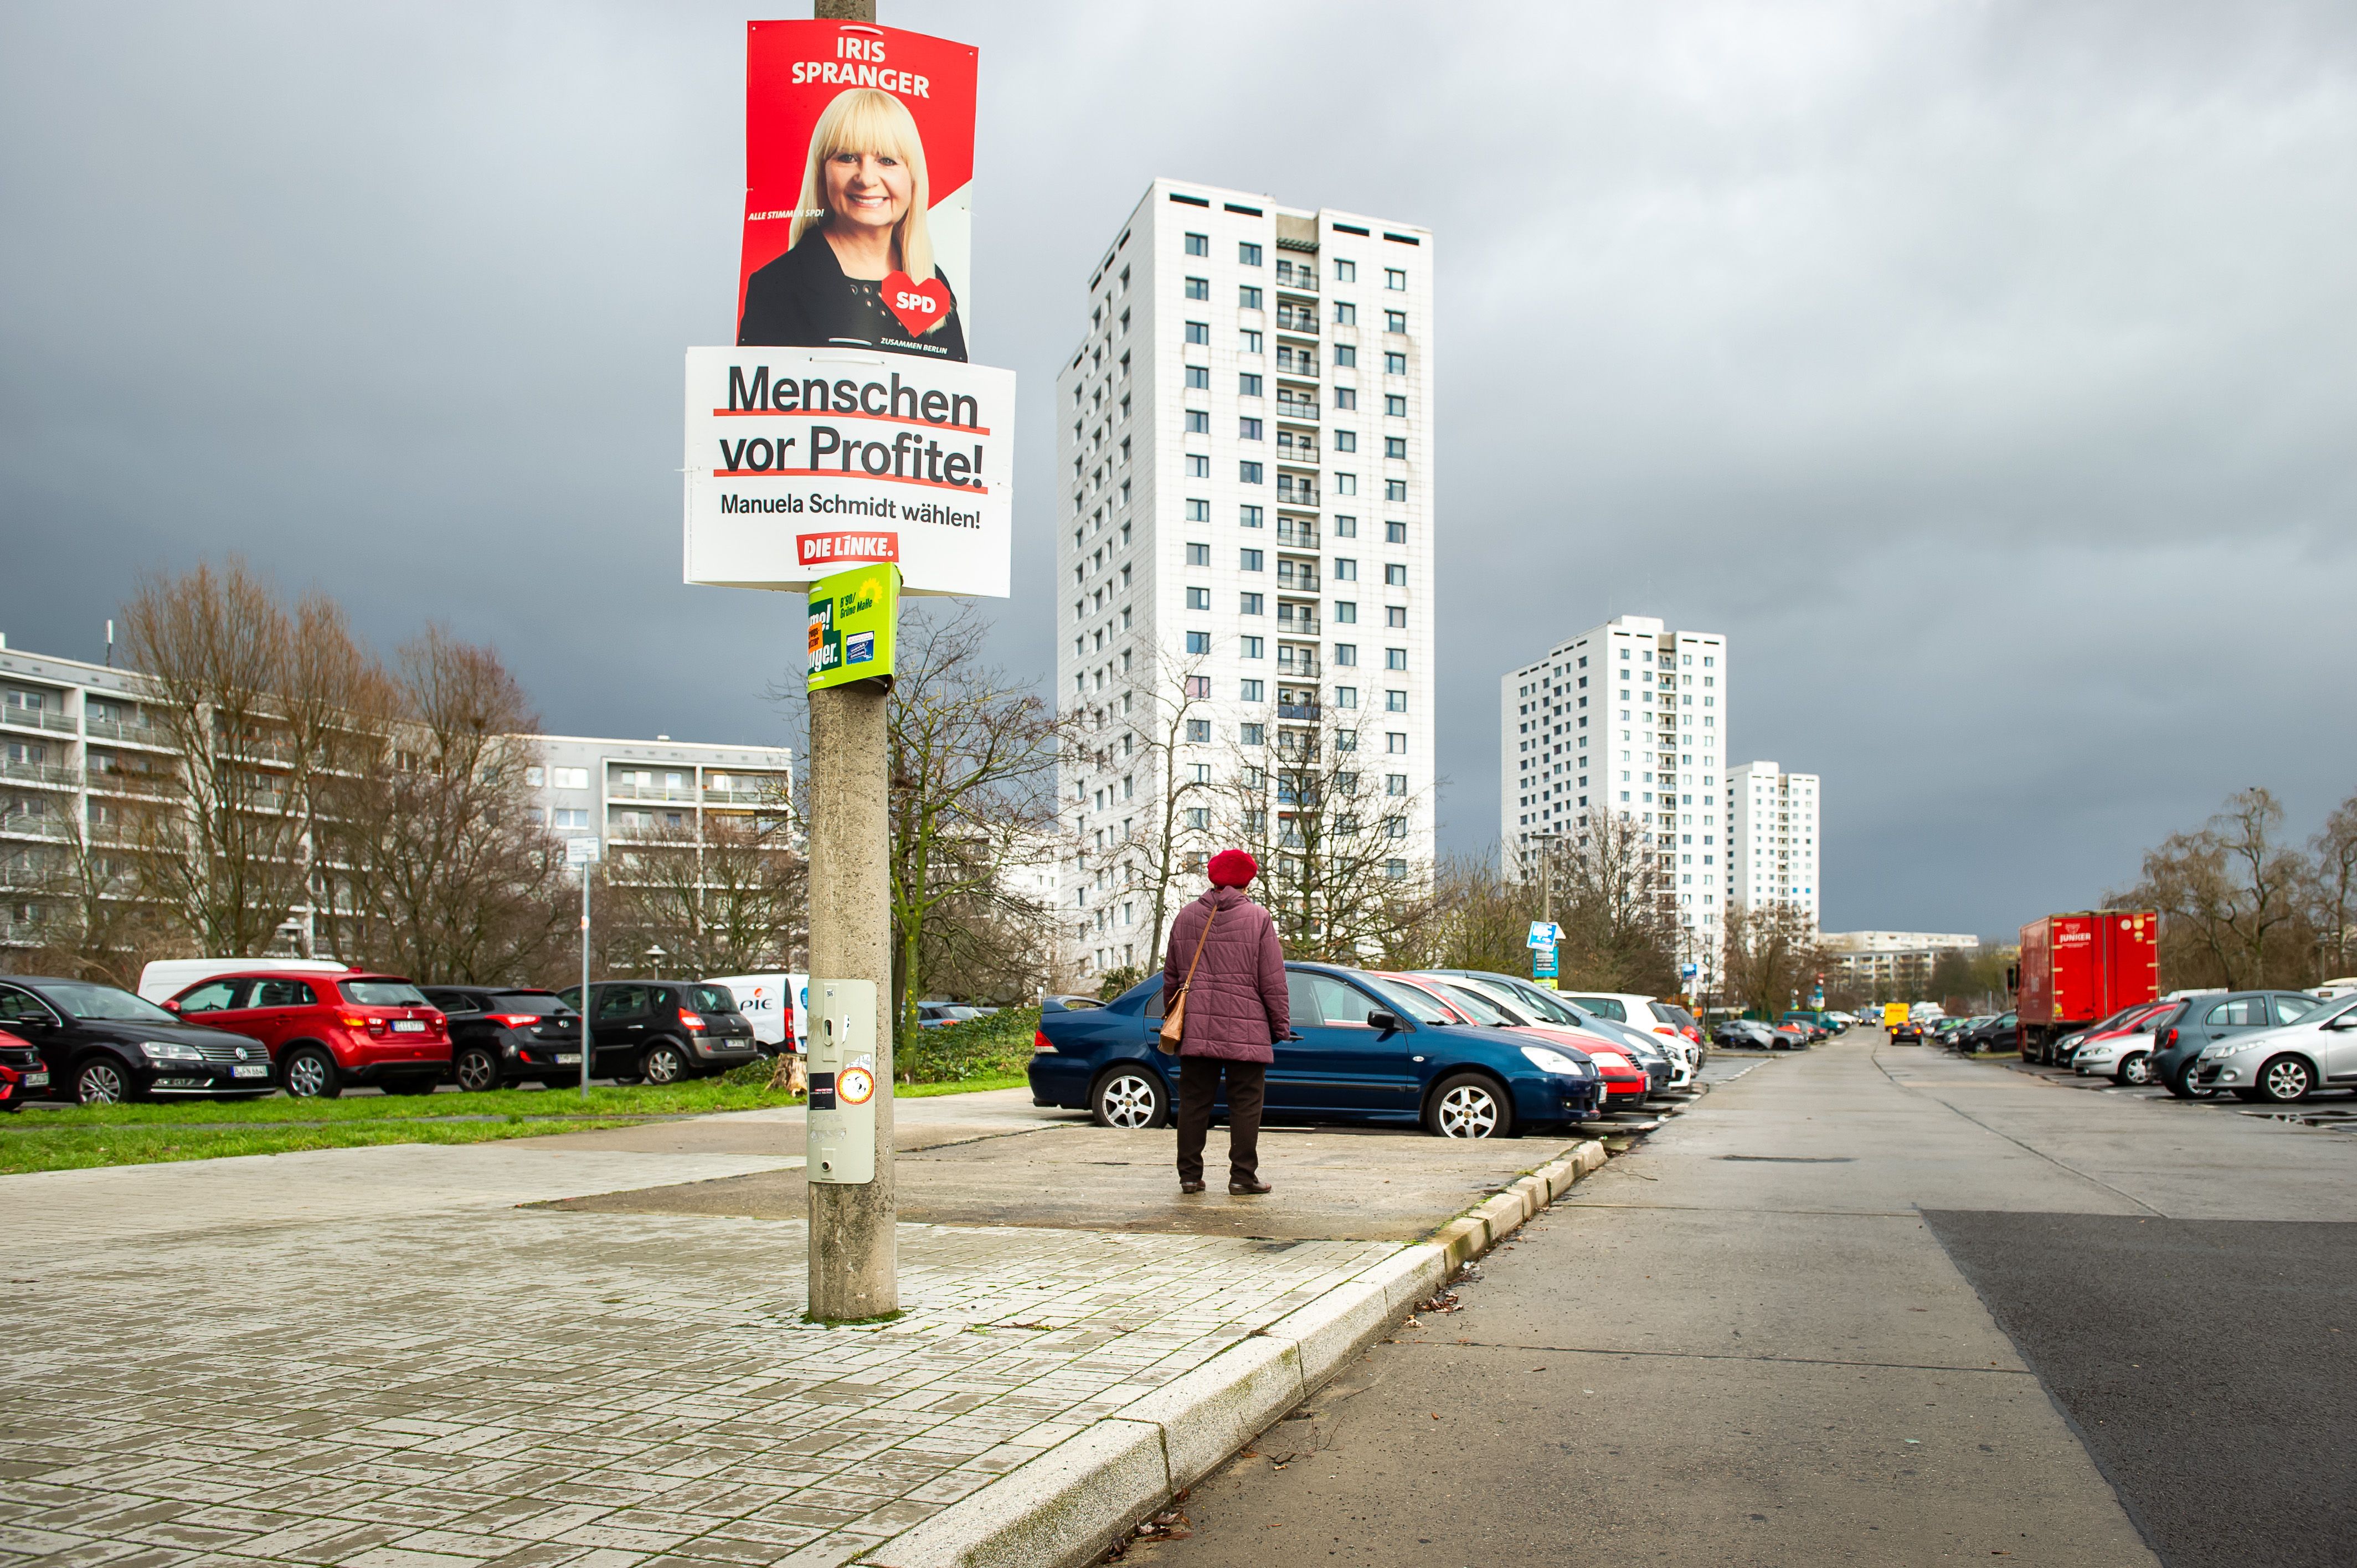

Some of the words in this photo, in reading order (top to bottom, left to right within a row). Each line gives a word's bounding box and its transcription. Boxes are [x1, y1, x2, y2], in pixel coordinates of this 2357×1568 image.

[837, 37, 886, 63] IRIS
[792, 61, 930, 99] SPRANGER
[748, 212, 766, 221] ALLE
[767, 210, 804, 219] STIMMEN
[805, 208, 825, 217] SPD!
[896, 291, 936, 313] SPD
[880, 337, 922, 350] ZUSAMMEN
[923, 344, 948, 354] BERLIN
[729, 366, 977, 429] Menschen
[719, 438, 795, 472] vor
[810, 426, 983, 488] Profite!
[721, 494, 804, 514] Manuela
[809, 493, 896, 519] Schmidt
[902, 503, 980, 529] wählen!
[804, 538, 832, 559] DIE
